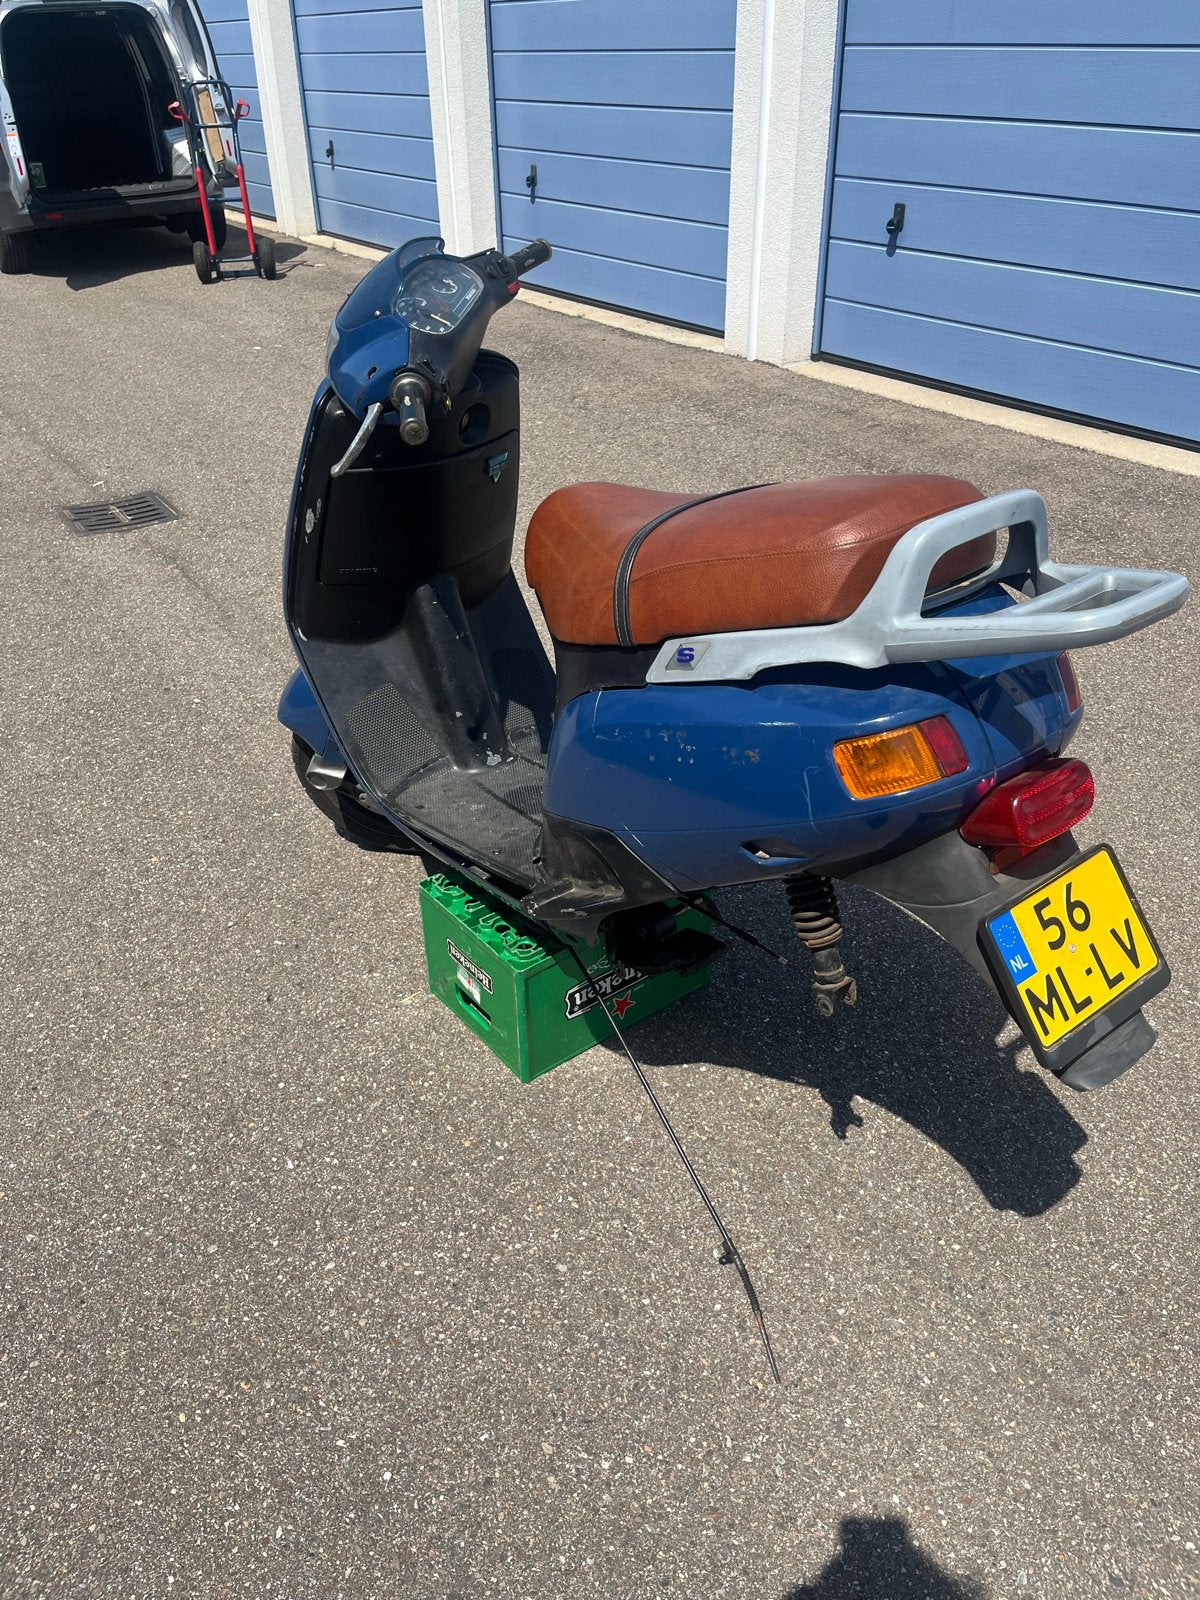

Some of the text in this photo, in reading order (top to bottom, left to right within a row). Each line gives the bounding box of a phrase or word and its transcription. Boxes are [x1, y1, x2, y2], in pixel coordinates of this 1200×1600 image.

[677, 647, 694, 663] S
[1033, 882, 1091, 950] 56
[450, 944, 489, 989] Heineken
[1009, 954, 1028, 973] NL
[1025, 918, 1140, 1037] ML-LV
